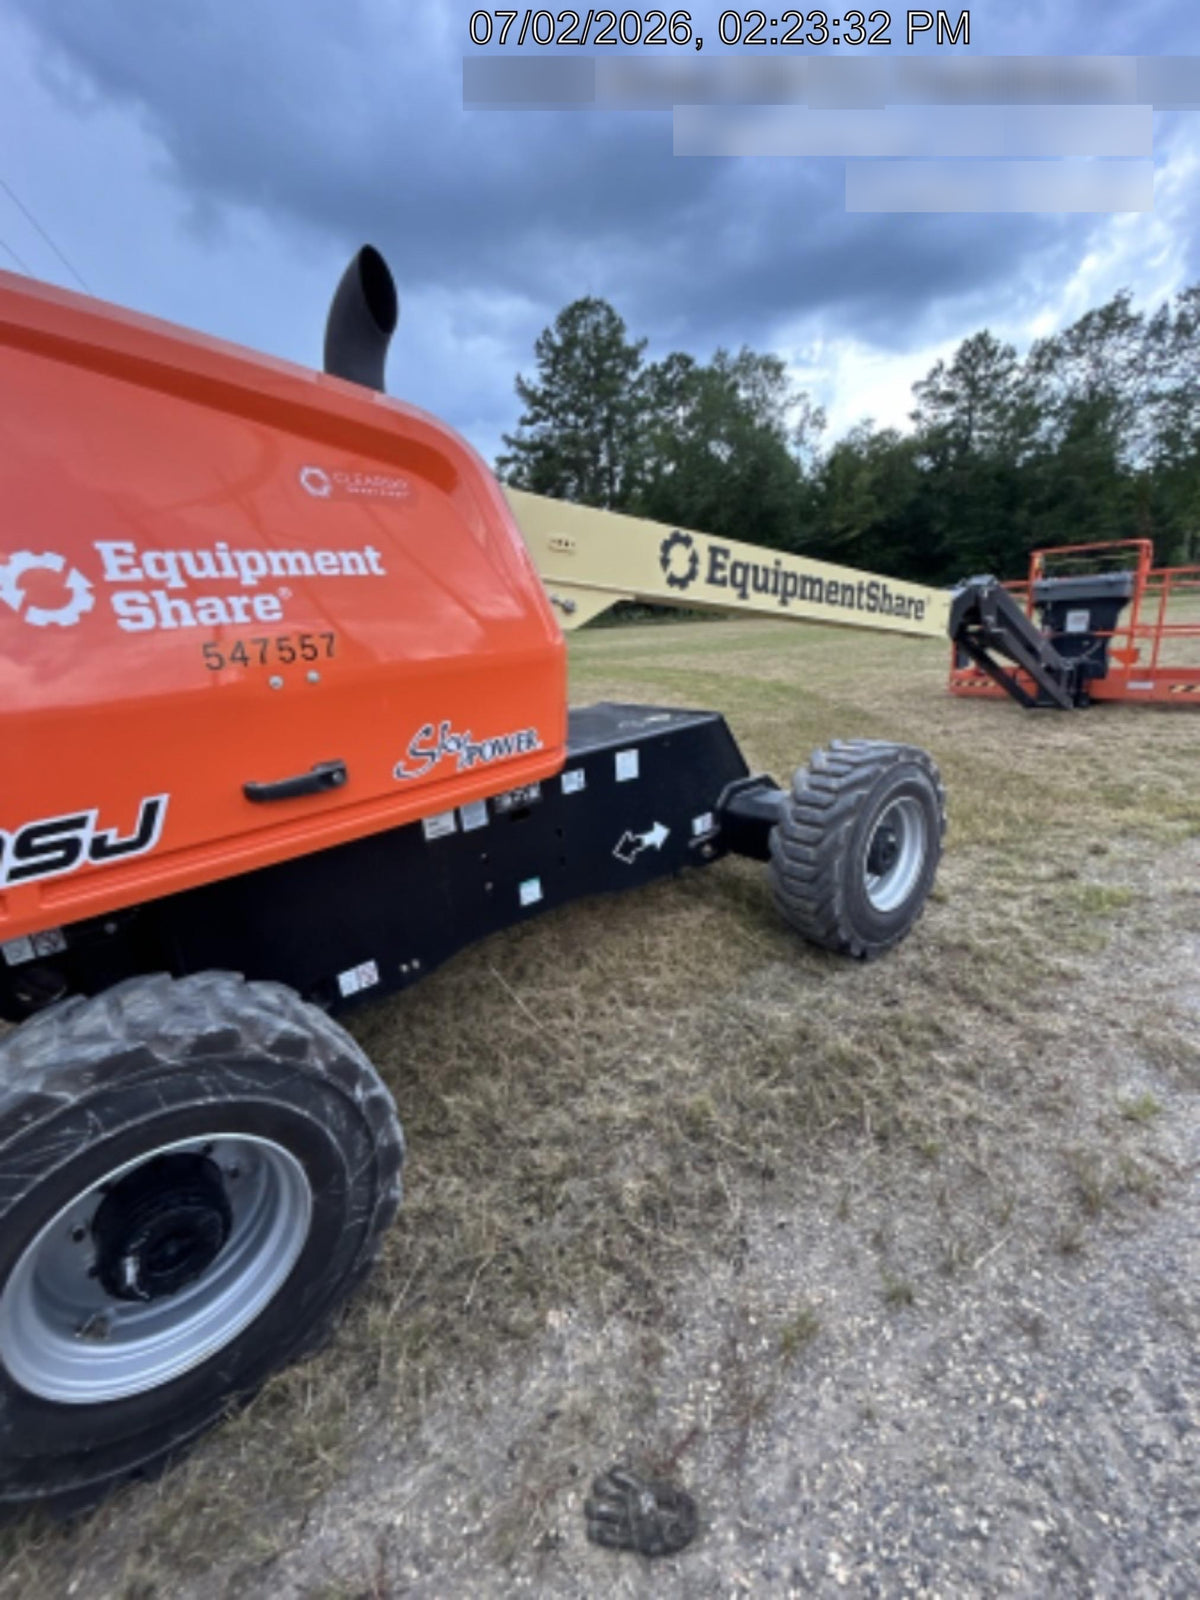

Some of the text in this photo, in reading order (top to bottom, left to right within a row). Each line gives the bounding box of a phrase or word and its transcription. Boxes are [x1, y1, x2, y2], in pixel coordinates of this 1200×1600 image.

[93, 541, 386, 587] Equipment
[706, 546, 926, 620] EquipmentShare
[203, 633, 336, 671] 547557
[0, 793, 170, 889] SJ
